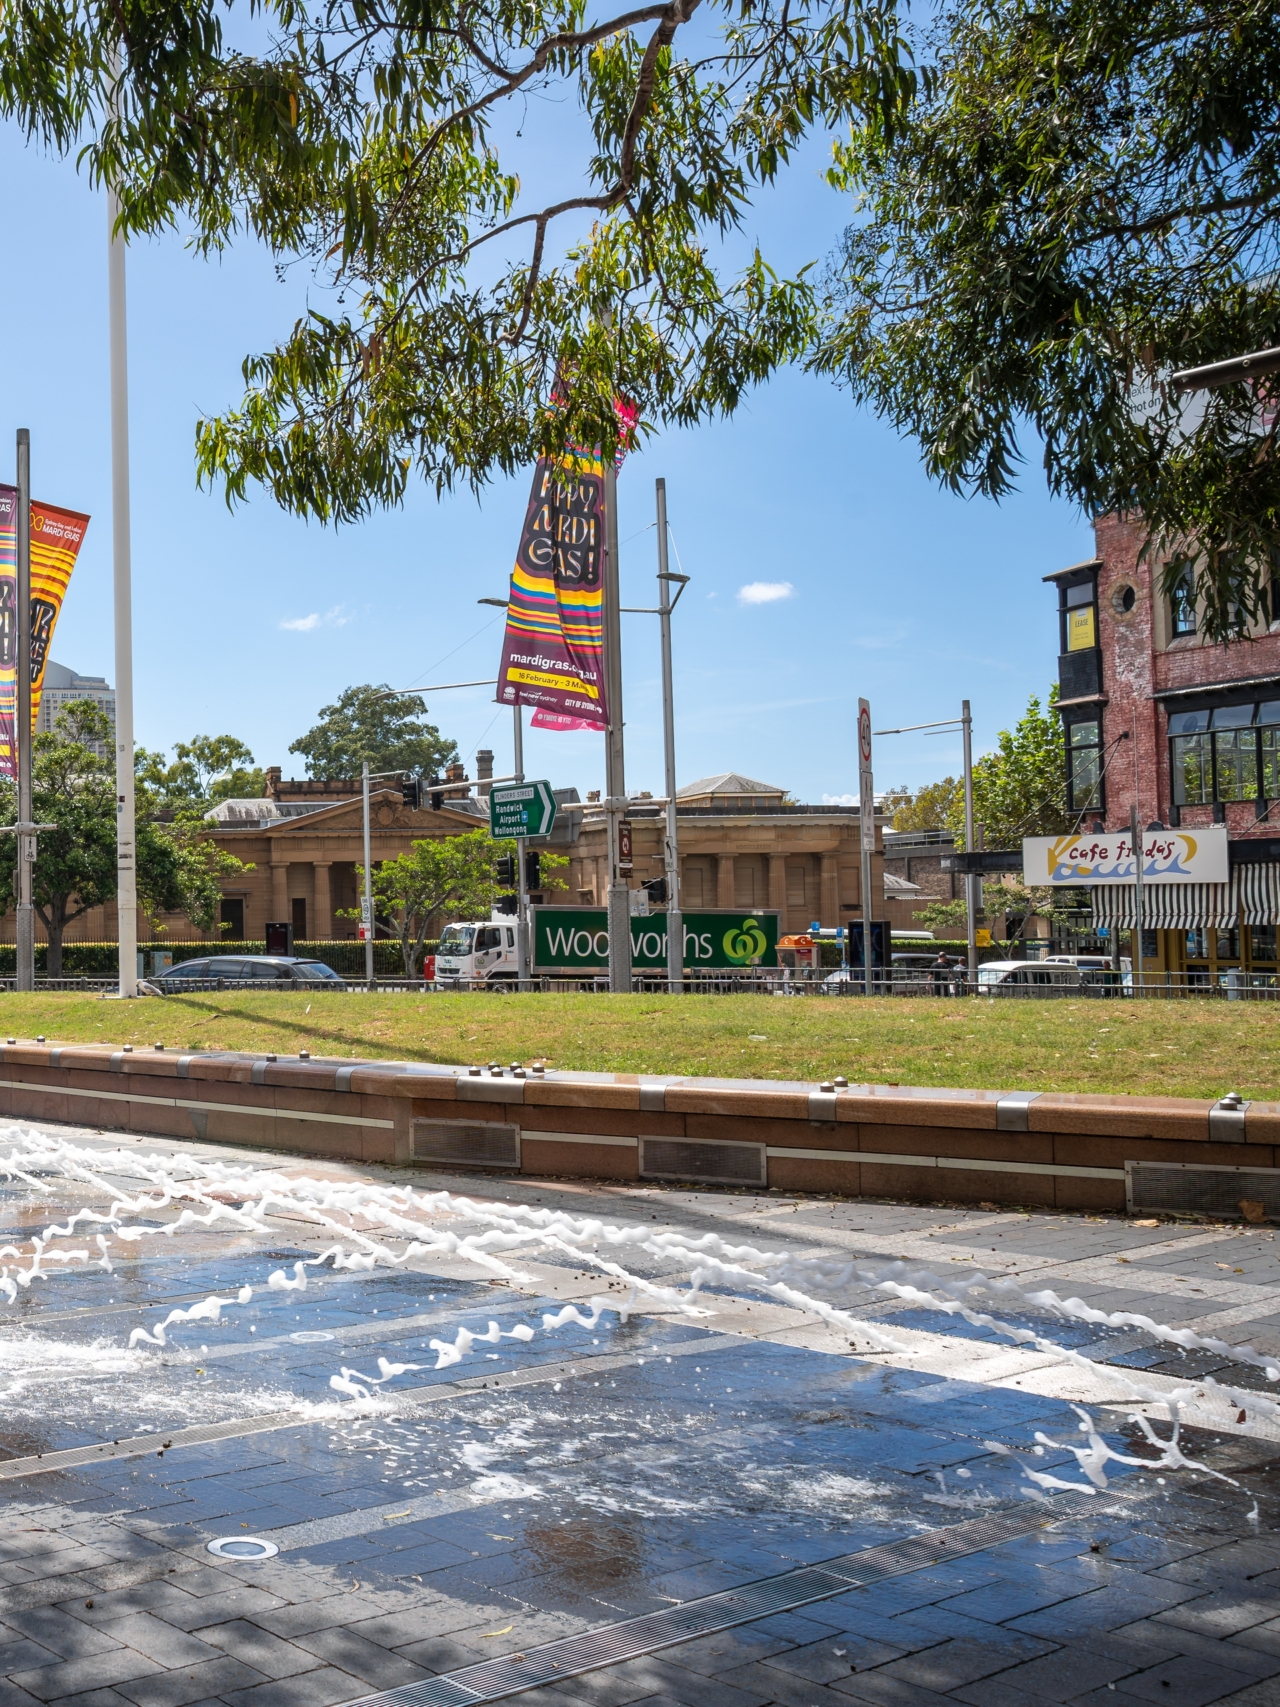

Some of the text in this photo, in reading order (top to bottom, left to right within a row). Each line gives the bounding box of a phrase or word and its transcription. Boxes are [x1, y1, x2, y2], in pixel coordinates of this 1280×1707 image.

[42, 524, 65, 537] MARDI
[1075, 619, 1089, 627] LEASE
[526, 673, 559, 686] February
[862, 723, 870, 746] 40
[496, 792, 515, 800] FLINDERS
[496, 803, 523, 813] Randwick
[500, 815, 520, 824] Airport
[494, 826, 527, 835] Wollongong
[1069, 839, 1175, 862] cafe frda's
[546, 924, 713, 958] Wooworhs
